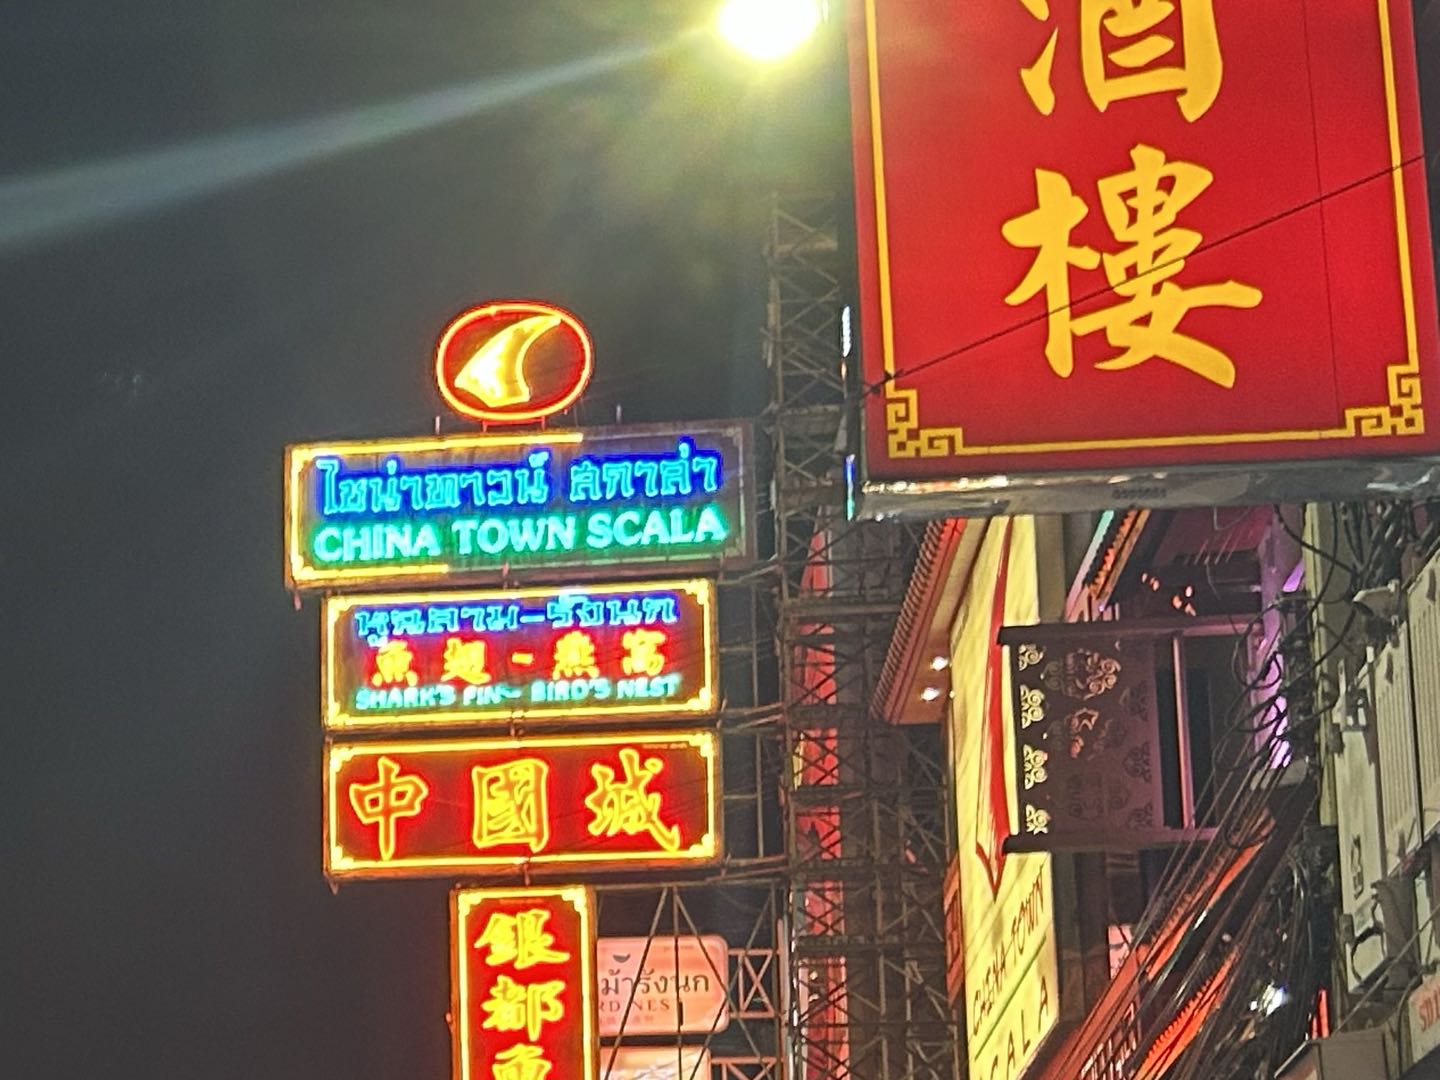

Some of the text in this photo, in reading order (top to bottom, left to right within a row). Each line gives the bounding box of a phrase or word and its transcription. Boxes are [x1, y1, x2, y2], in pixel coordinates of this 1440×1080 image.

[314, 504, 726, 562] CHINA TOWN SCALA
[355, 684, 457, 710] SHARK'S
[530, 679, 612, 702] BIRD'S
[616, 674, 681, 700] NEST
[348, 748, 681, 862] 中國城
[973, 863, 1045, 1036] CHINA TOWN
